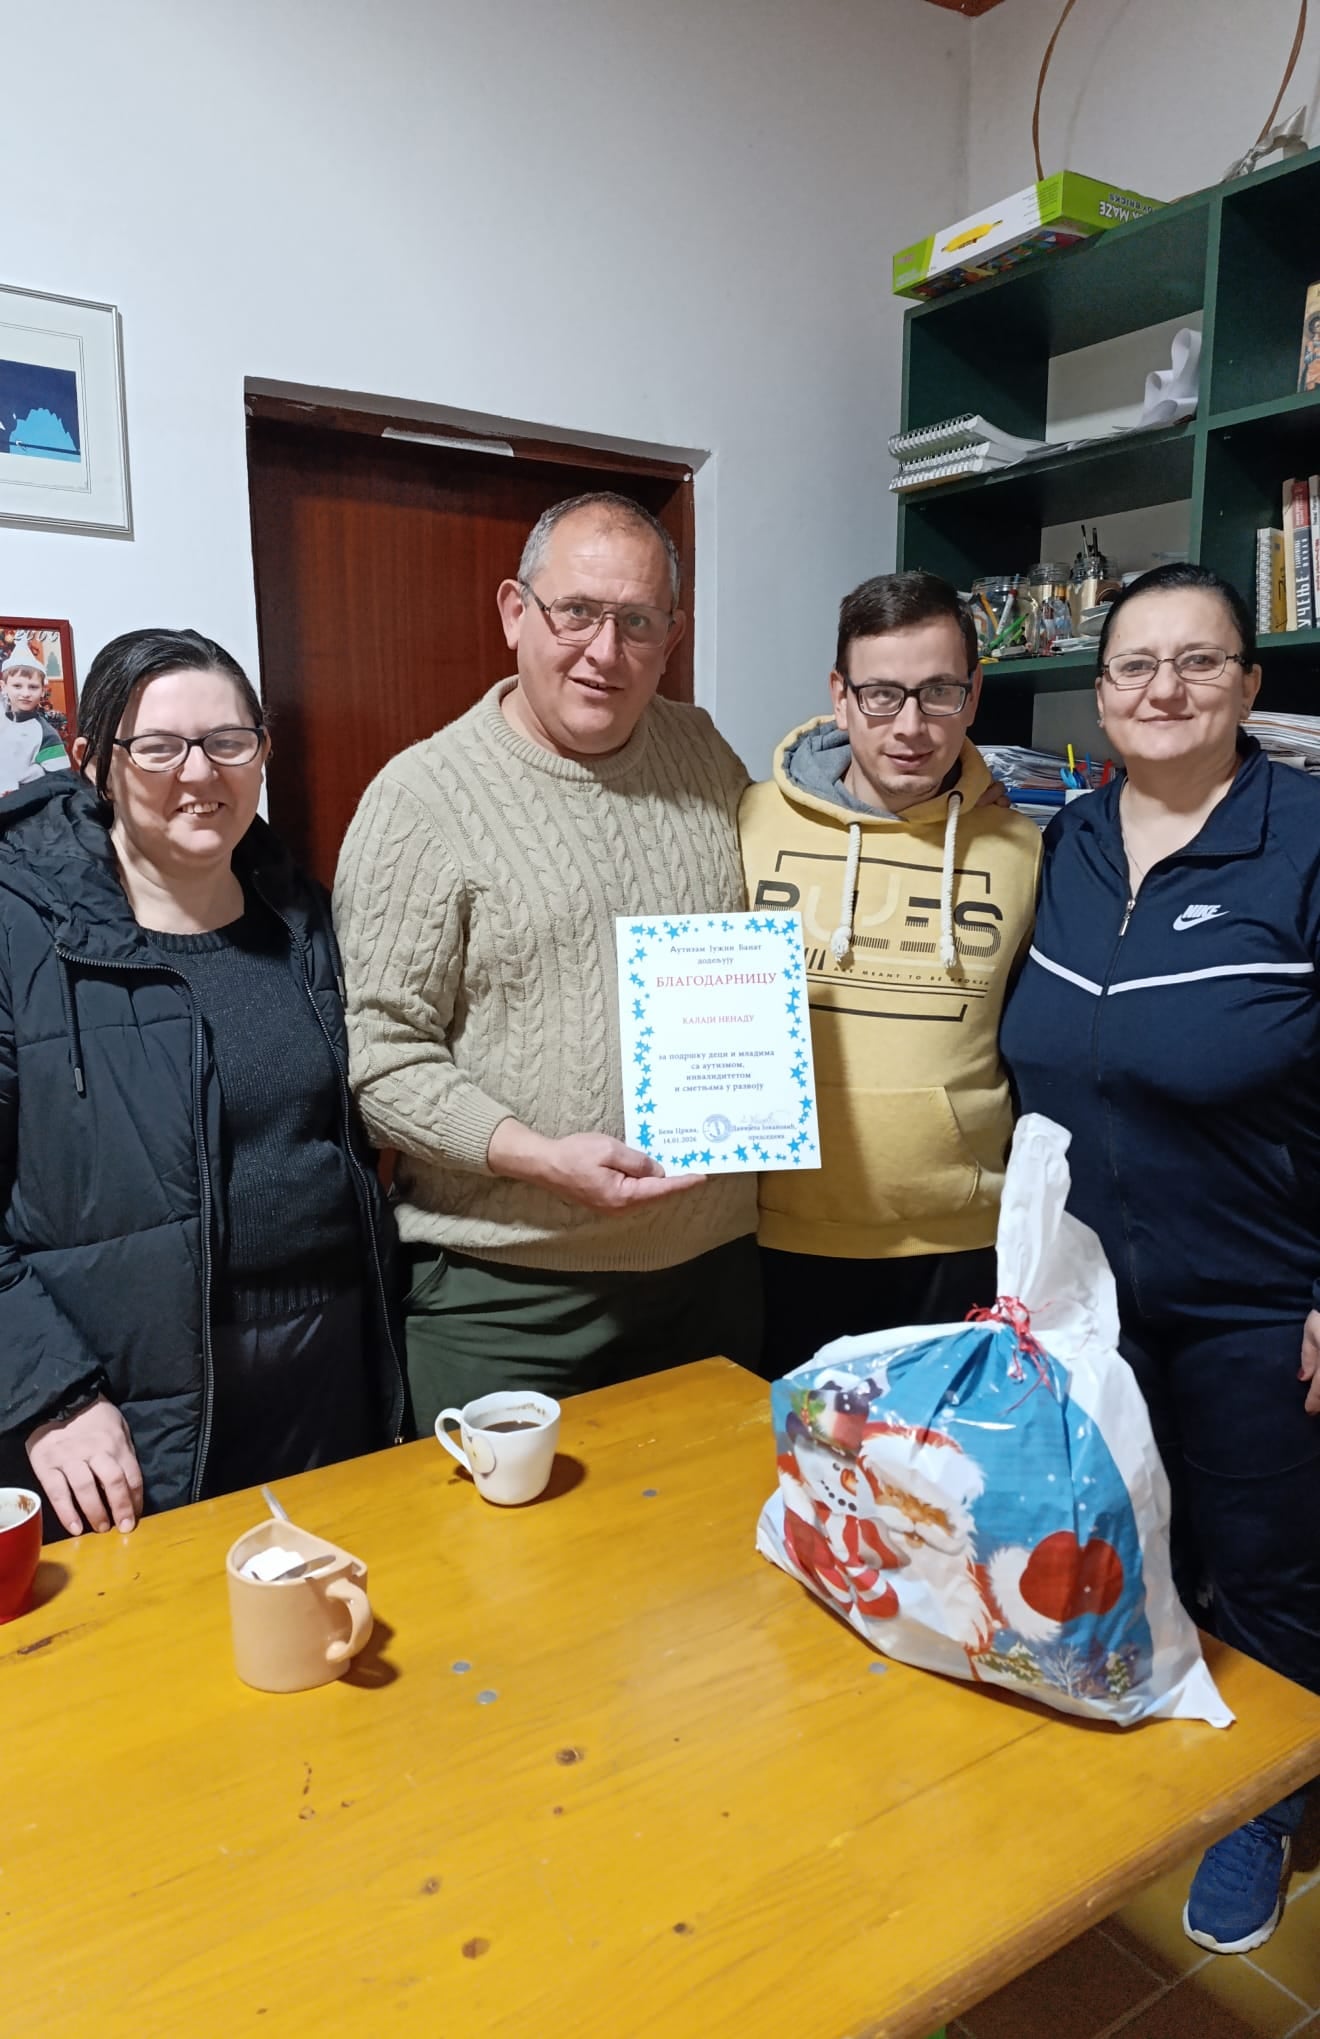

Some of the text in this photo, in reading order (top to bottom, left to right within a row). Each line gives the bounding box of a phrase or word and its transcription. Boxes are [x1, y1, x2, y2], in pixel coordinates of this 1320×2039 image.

[1099, 201, 1130, 222] MAZE
[1295, 574, 1311, 628] УЧЕЊЕ
[1181, 904, 1222, 919] NIKE
[670, 945, 705, 955] Аутизам
[656, 972, 777, 988] БЛАГОДАРНИЦУ
[718, 1014, 755, 1024] НЕНАДУ
[669, 1053, 706, 1062] подршку
[708, 1051, 728, 1059] деци
[738, 1049, 775, 1057] младима
[686, 1072, 751, 1081] инвалидитетом
[733, 1082, 764, 1092] развоју
